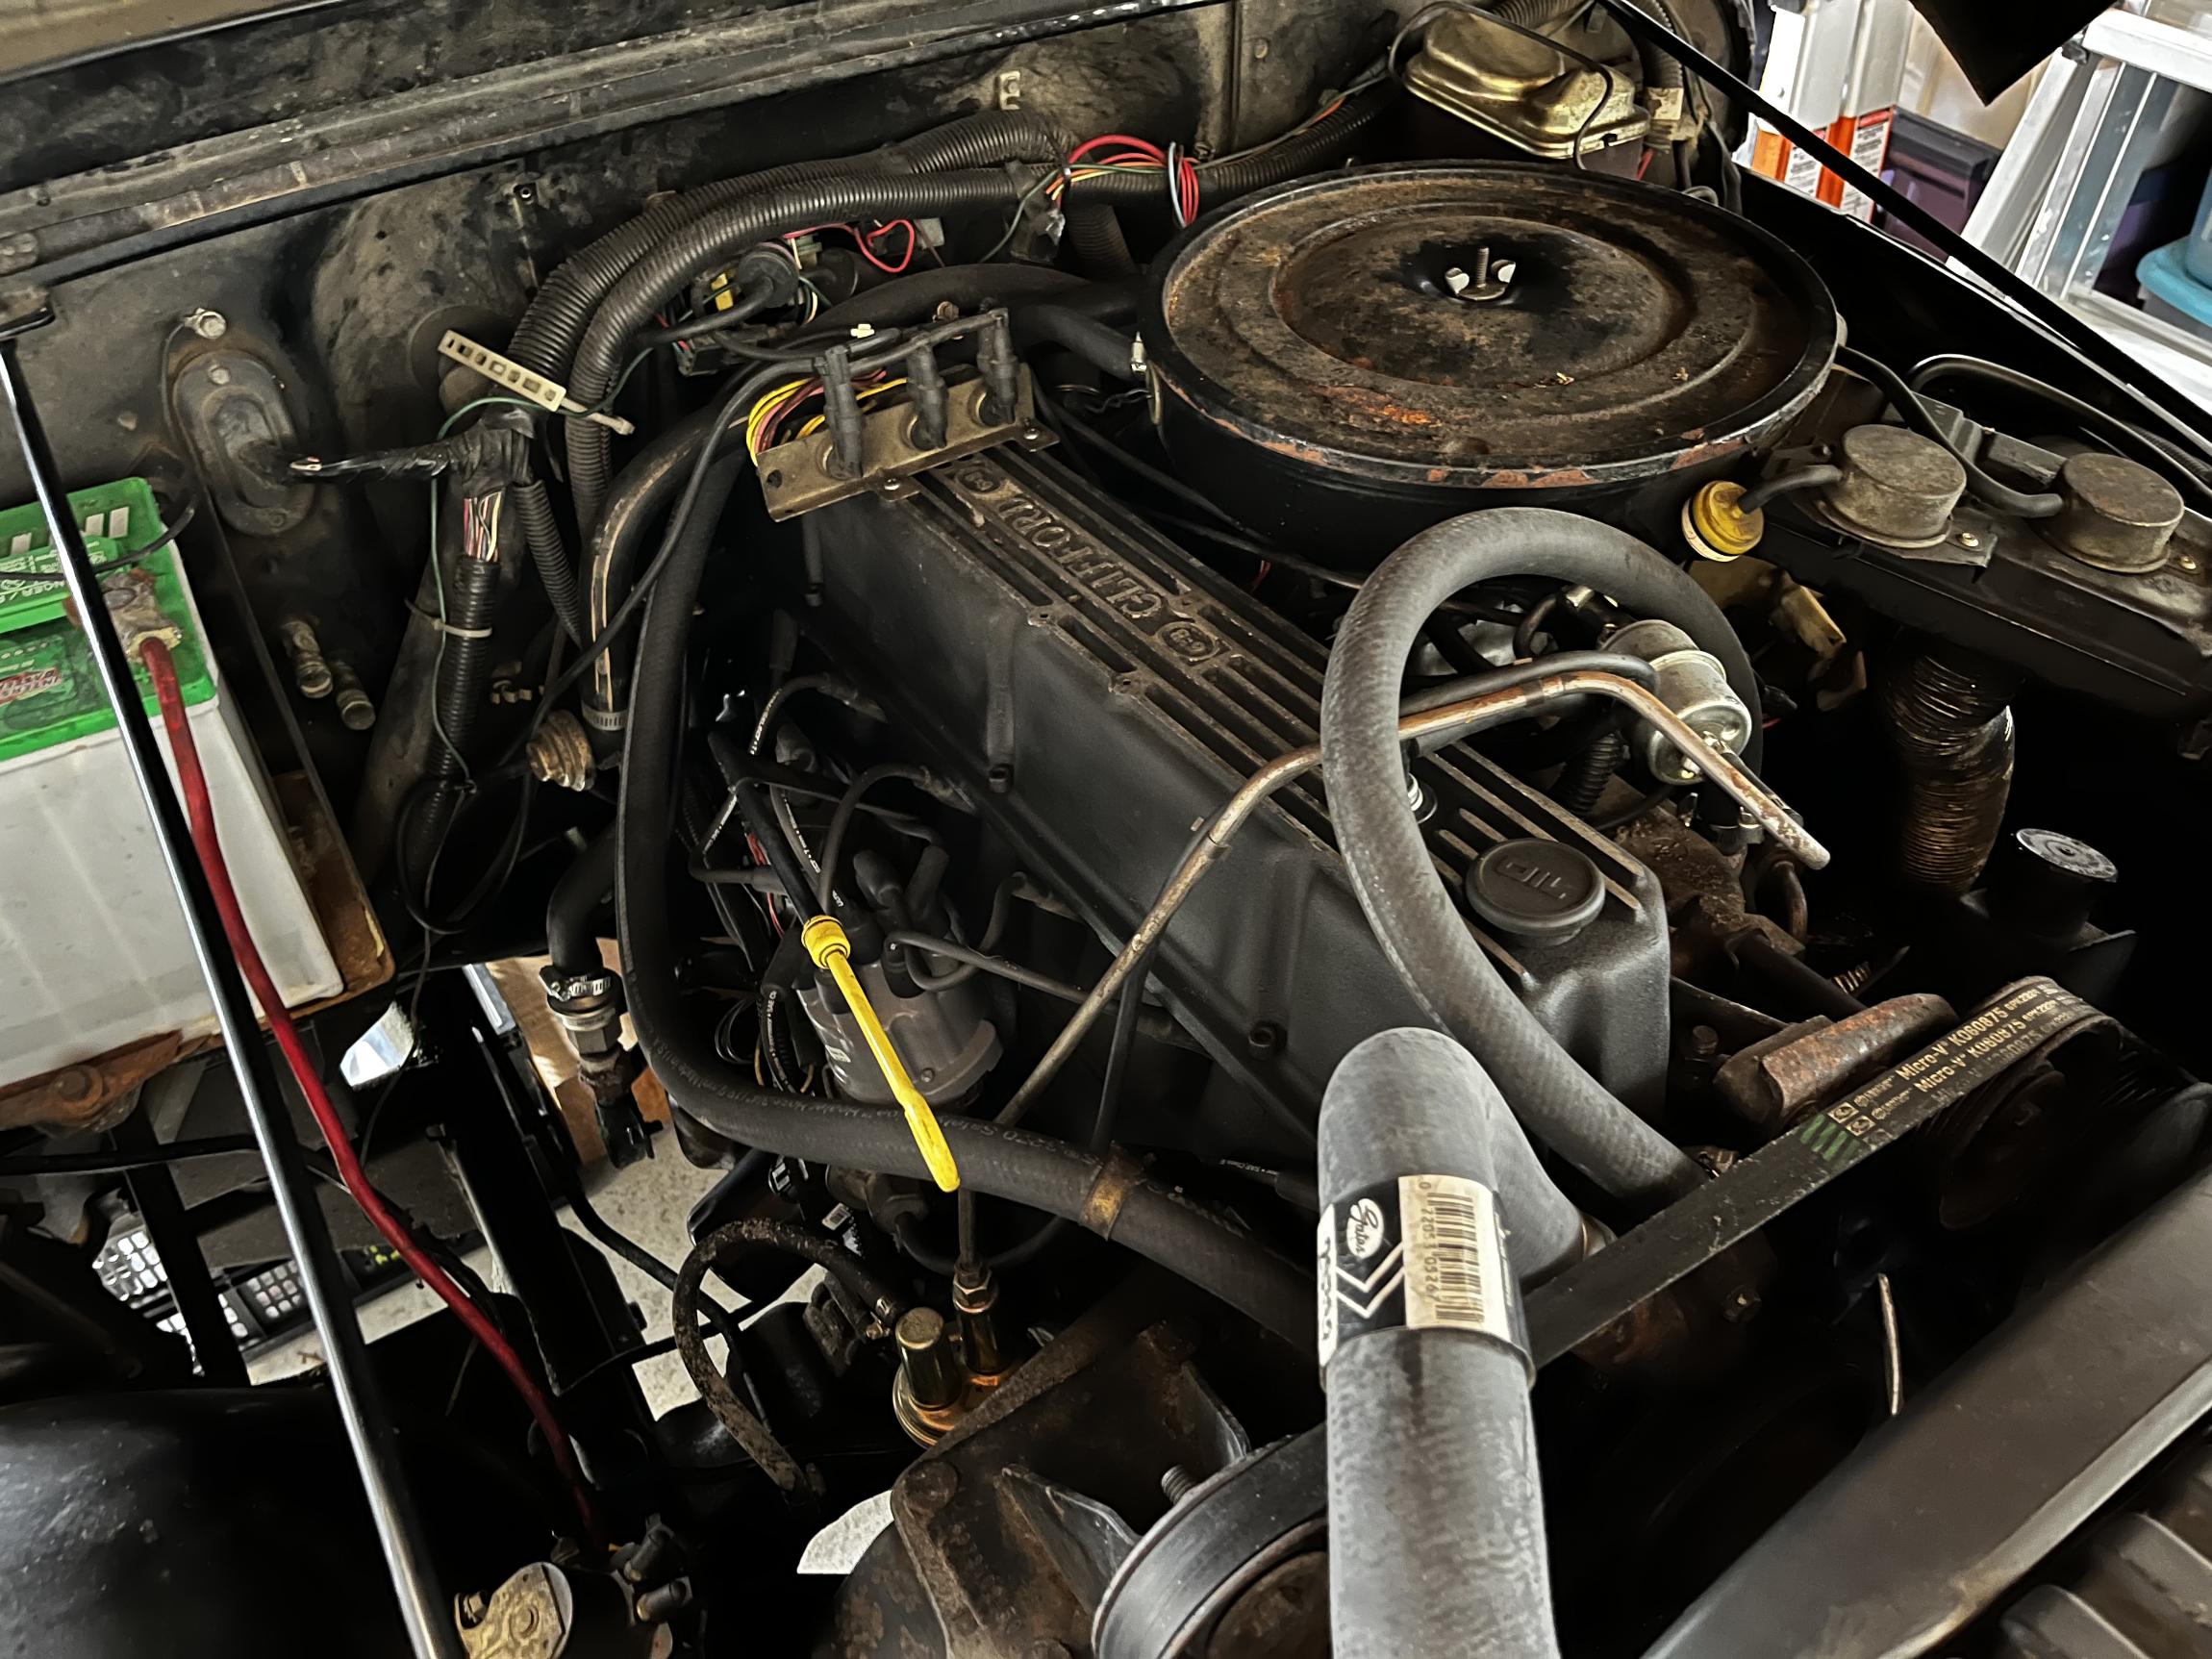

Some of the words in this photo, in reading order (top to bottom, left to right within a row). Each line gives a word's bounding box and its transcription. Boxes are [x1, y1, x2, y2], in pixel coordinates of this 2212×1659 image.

[997, 497, 1163, 619] CLIFFORD
[1496, 857, 1567, 899] OIL
[1349, 1203, 1379, 1254] Gates
